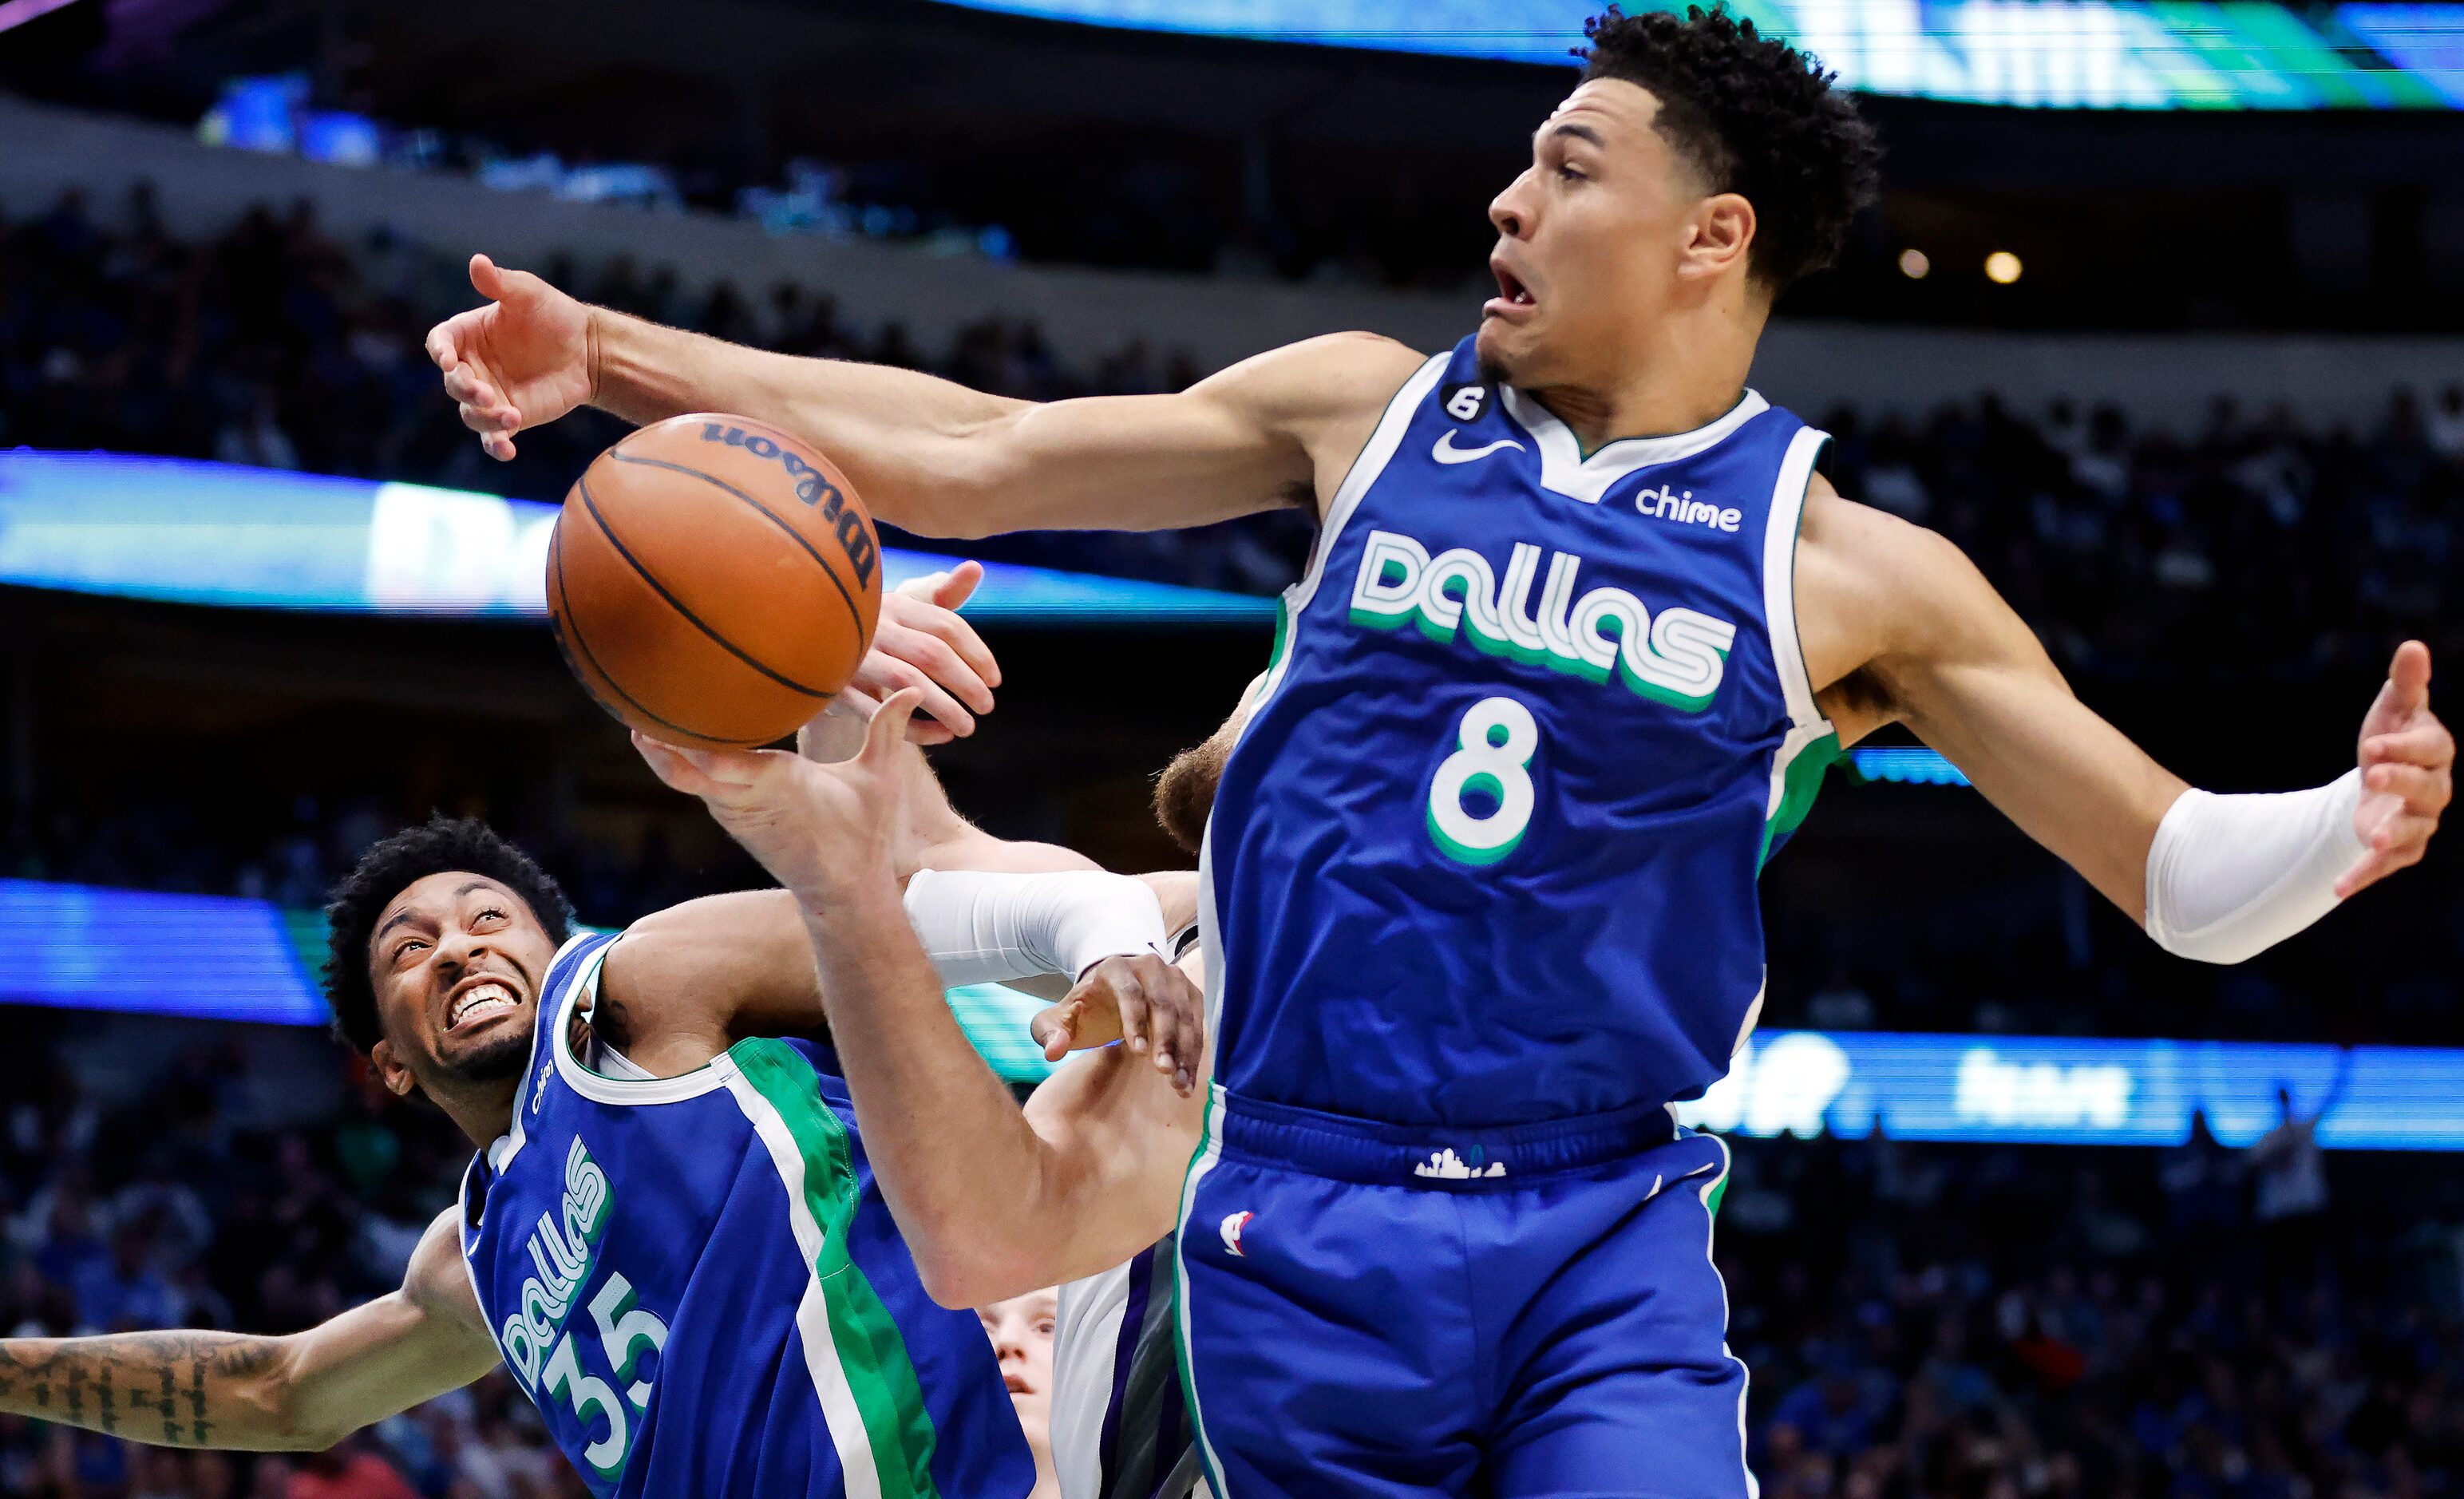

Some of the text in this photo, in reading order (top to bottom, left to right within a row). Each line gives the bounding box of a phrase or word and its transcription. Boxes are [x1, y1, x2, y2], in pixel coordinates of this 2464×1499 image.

[1446, 386, 1485, 421] 6
[700, 423, 875, 592] Wilson
[1635, 484, 1742, 532] chime
[1426, 697, 1539, 867] 8
[532, 1058, 554, 1115] chim
[542, 1271, 670, 1482] 35
